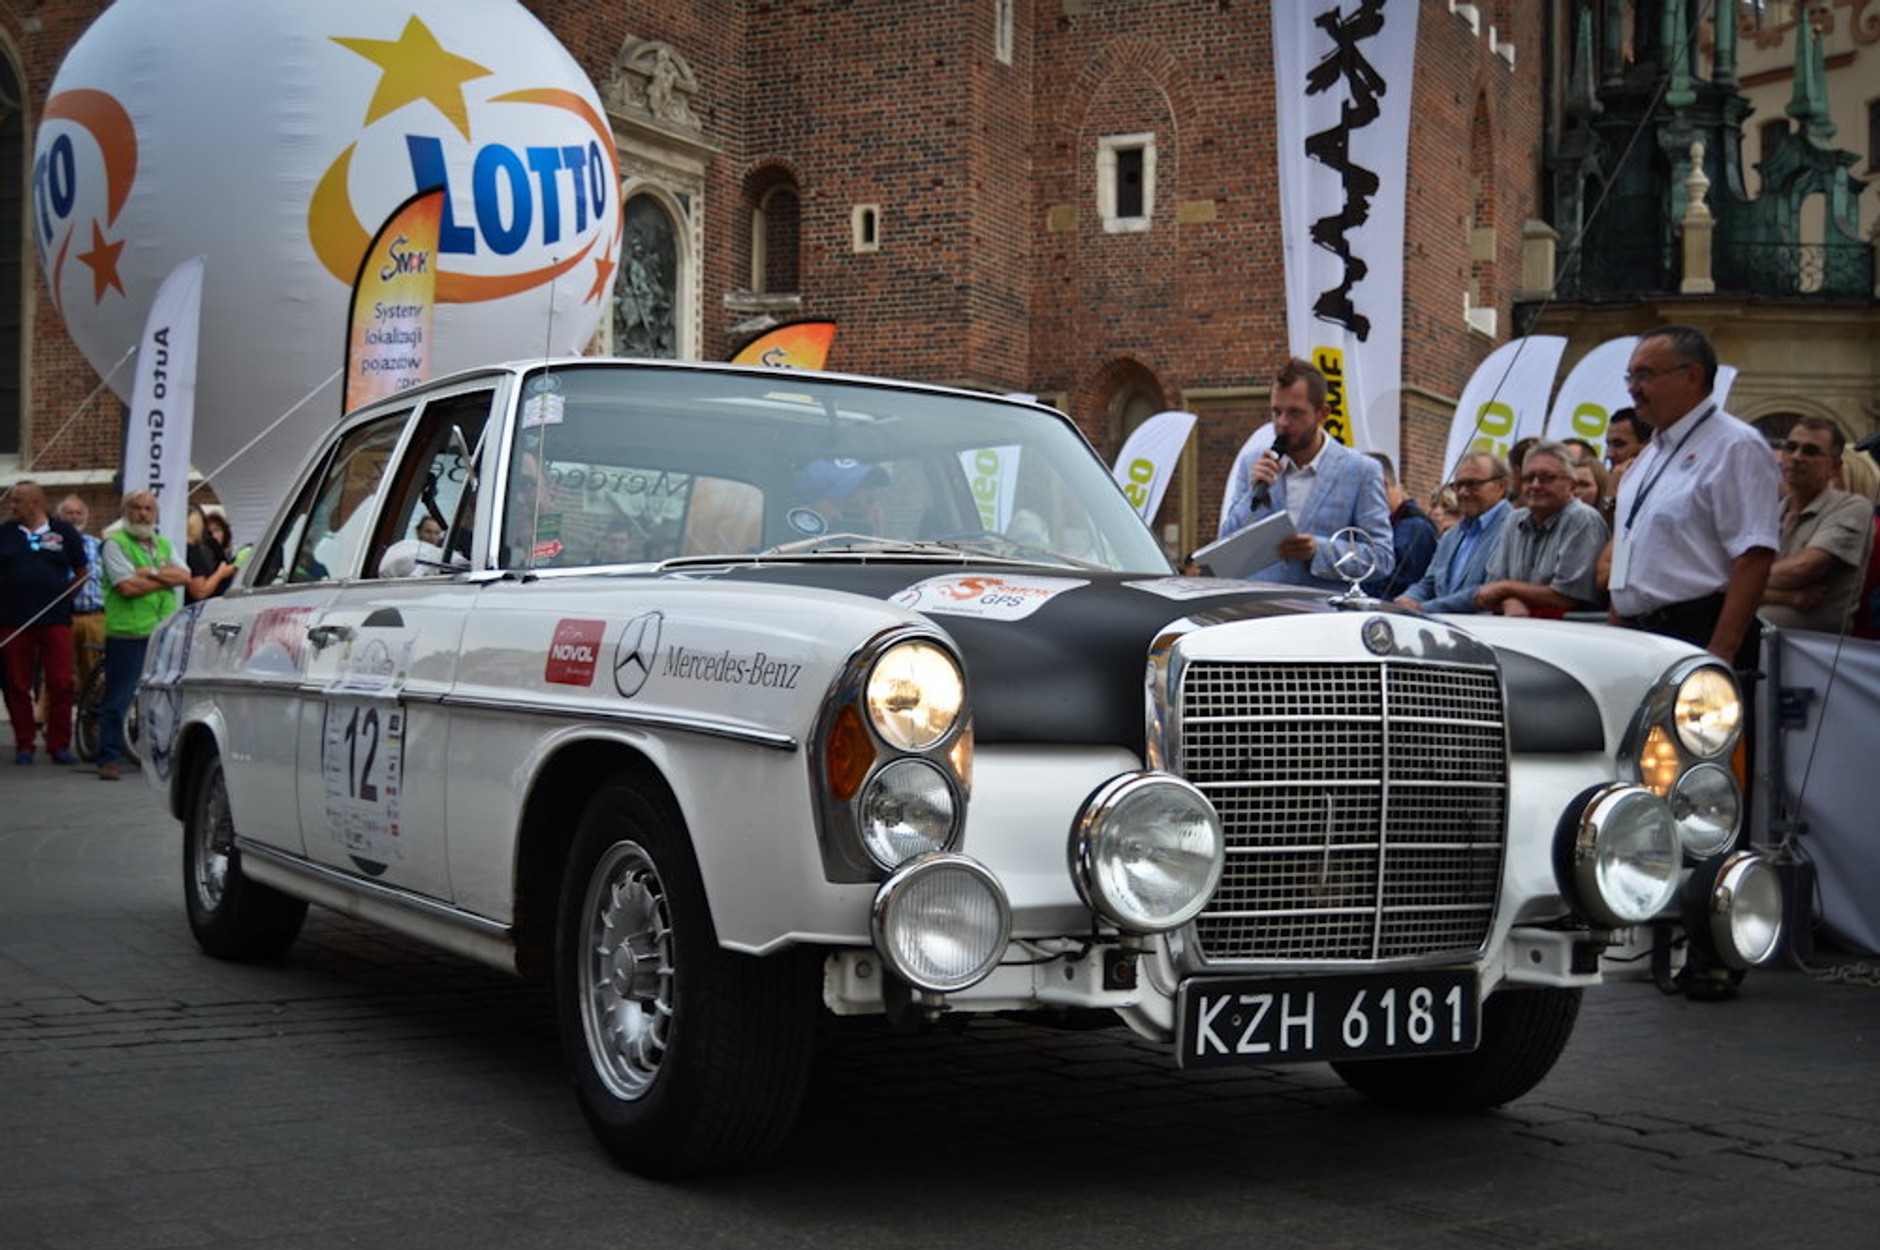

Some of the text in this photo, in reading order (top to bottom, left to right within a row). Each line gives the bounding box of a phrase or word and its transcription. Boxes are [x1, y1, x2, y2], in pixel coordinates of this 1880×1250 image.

[406, 134, 606, 256] LOTTO
[980, 594, 1024, 607] GPS
[551, 644, 594, 662] NOVOL
[662, 645, 802, 690] Mercedes-Benz
[344, 706, 378, 802] 12
[1196, 985, 1462, 1056] KZH 6181
